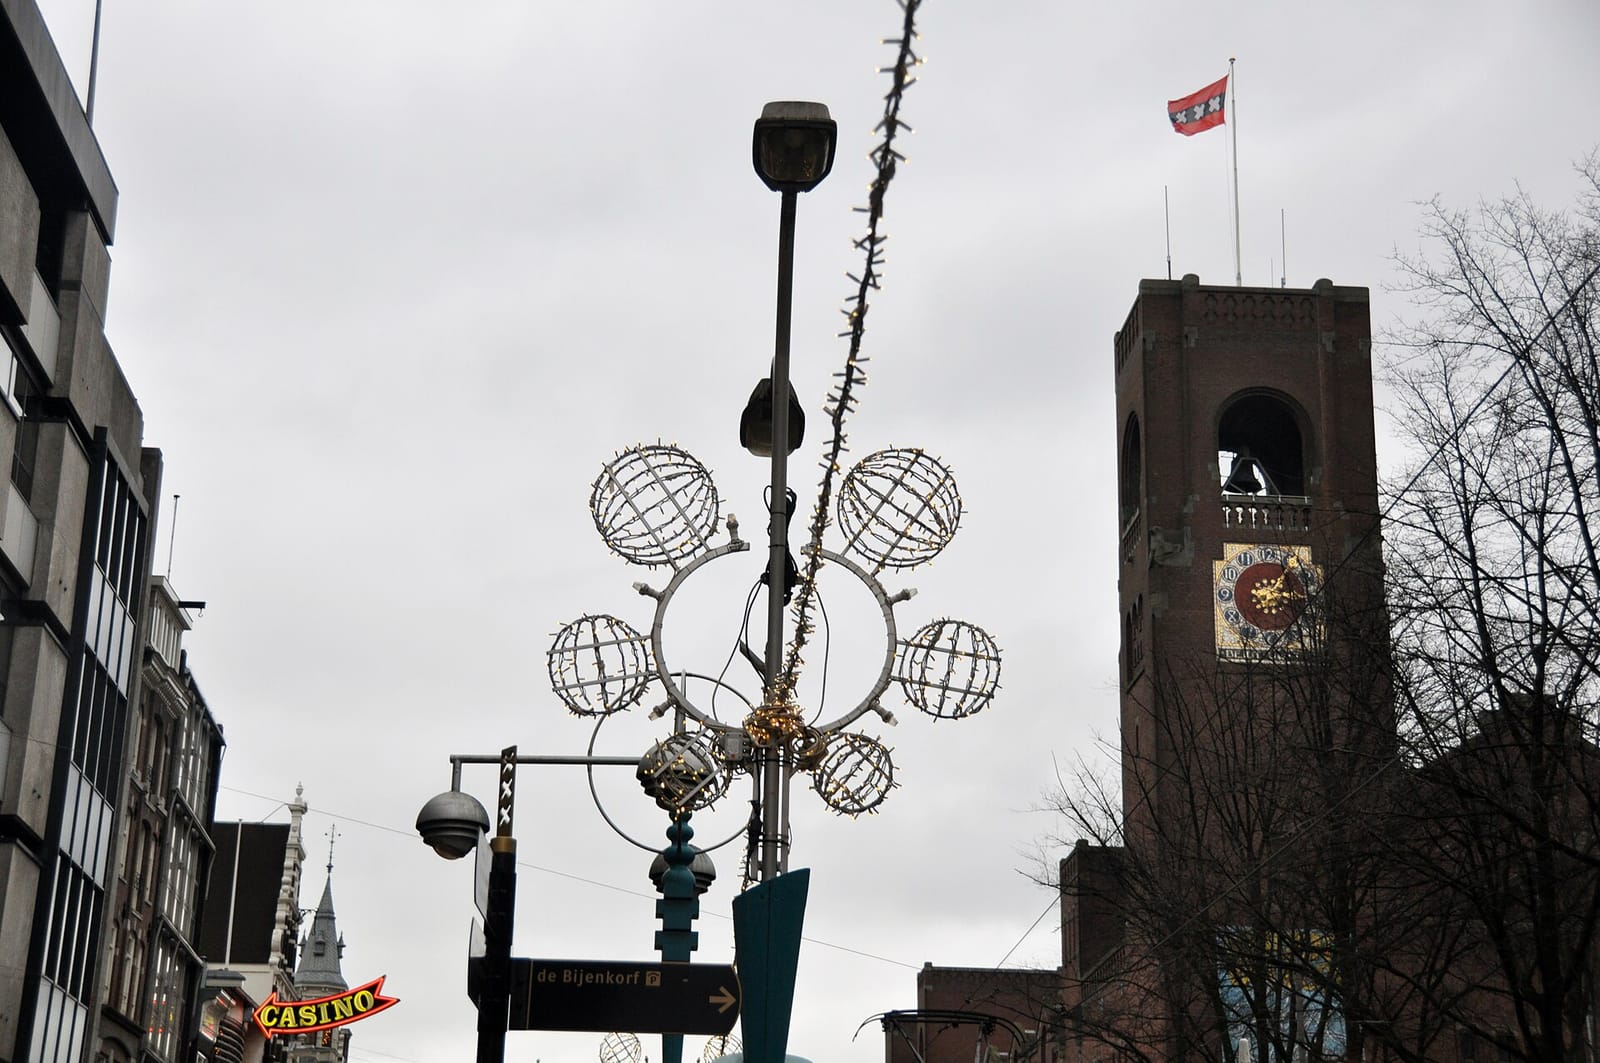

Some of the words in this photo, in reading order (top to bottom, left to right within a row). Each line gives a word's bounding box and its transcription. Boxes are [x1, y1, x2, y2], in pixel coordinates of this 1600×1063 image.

[1240, 553, 1251, 566] 11
[1261, 547, 1273, 561] 12
[1224, 567, 1236, 581] 10
[1220, 588, 1229, 600] 9
[1226, 608, 1237, 624] 8
[537, 969, 557, 983] de
[563, 969, 640, 987] Bijenkorf
[260, 989, 375, 1028] CASINO
